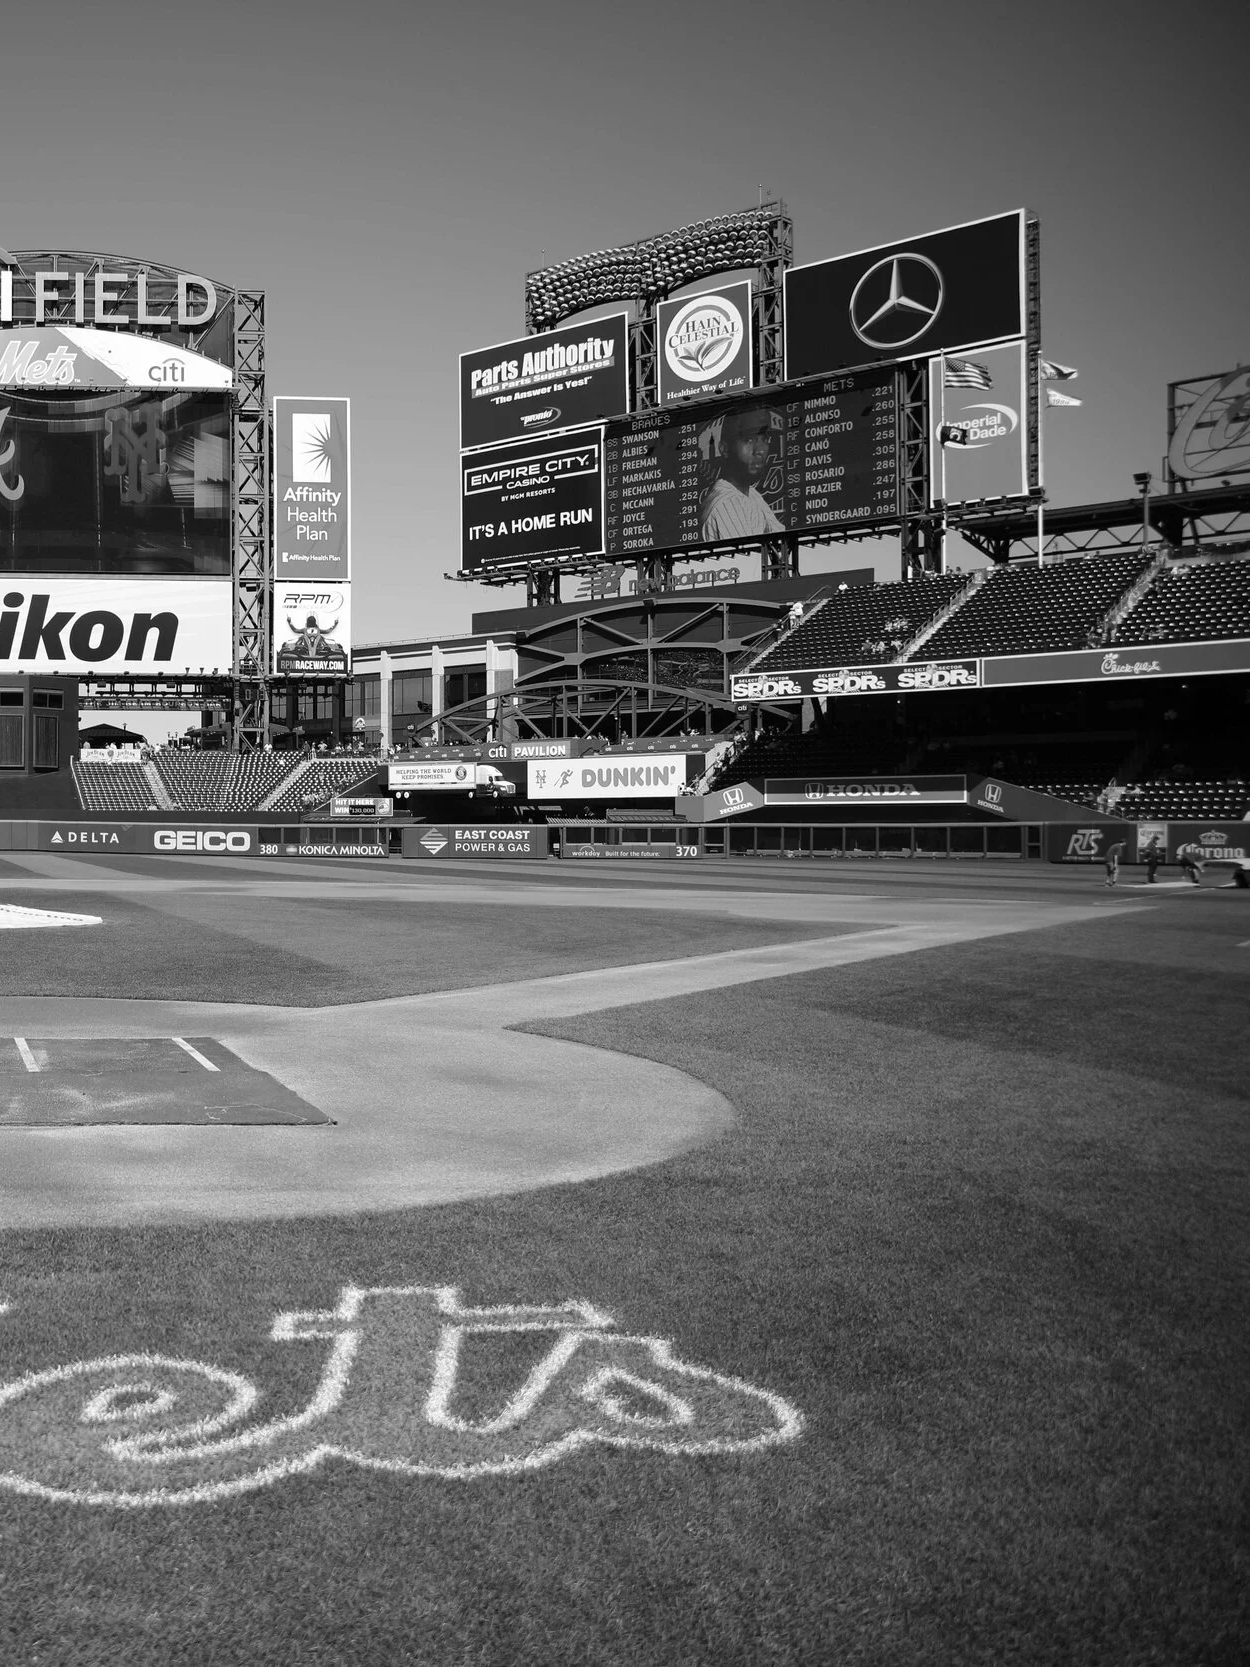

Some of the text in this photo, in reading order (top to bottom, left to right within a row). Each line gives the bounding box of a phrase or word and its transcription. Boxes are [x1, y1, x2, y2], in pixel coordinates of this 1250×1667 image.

[36, 272, 217, 325] FIELD
[686, 316, 722, 333] HAIN
[668, 322, 739, 348] CELESTIAL
[471, 337, 615, 390] Parts Authority
[148, 363, 185, 382] citi
[475, 359, 610, 397] Auto Parts Super Stores
[514, 386, 552, 400] Answer
[553, 383, 564, 391] Is
[667, 377, 744, 400] Healthier Way of Life
[823, 378, 855, 393] METS
[804, 395, 836, 410] NIMMO
[632, 415, 671, 431] BRAVES
[804, 409, 841, 424] ALONSO
[804, 421, 853, 438] CONFORTO
[969, 425, 1007, 440] Dade
[622, 430, 659, 445] SWANSON
[804, 438, 830, 452] CANÓ
[622, 445, 648, 458] ALBIES
[622, 457, 657, 471] FREEMAN
[805, 453, 832, 467] DAVIS
[471, 464, 540, 486] EMPIRE
[622, 469, 662, 484] MARKAKIS
[805, 466, 845, 481] ROSARIO
[506, 475, 550, 489] CASINO
[622, 480, 676, 497] HECHAVARRÍA
[805, 481, 842, 496] FRAZIER
[283, 487, 341, 506] Affinity
[510, 493, 525, 501] MGM
[526, 487, 556, 498] RESORTS
[622, 497, 654, 510] MCCANN
[805, 498, 828, 510] NIDO
[287, 507, 337, 523] Health
[622, 512, 645, 524] JOYCE
[805, 506, 871, 525] SYNDERGAARD
[469, 508, 593, 540] IT'S A HOME RUN
[623, 524, 653, 537] ORTEGA
[296, 524, 329, 541] Plan
[623, 537, 654, 550] SOROKA
[289, 554, 310, 562] Affinity
[629, 566, 741, 592] new balance
[284, 593, 331, 604] RPM
[280, 660, 344, 670] RPMRACEWAY.COM
[489, 745, 566, 759] citi PAVILION
[581, 766, 676, 788] DUNKIN'
[827, 784, 921, 797] HONDA
[719, 801, 753, 814] HONDA
[977, 800, 1004, 813] HONDA
[68, 831, 119, 844] DELTA
[154, 830, 251, 852] GEICO
[455, 830, 530, 840] EAST COAST
[1067, 829, 1103, 855] RTS
[260, 844, 278, 855] 380
[299, 845, 385, 855] KONICA MINOLTA
[455, 843, 530, 852] POWER & GAS
[676, 846, 698, 857] 370
